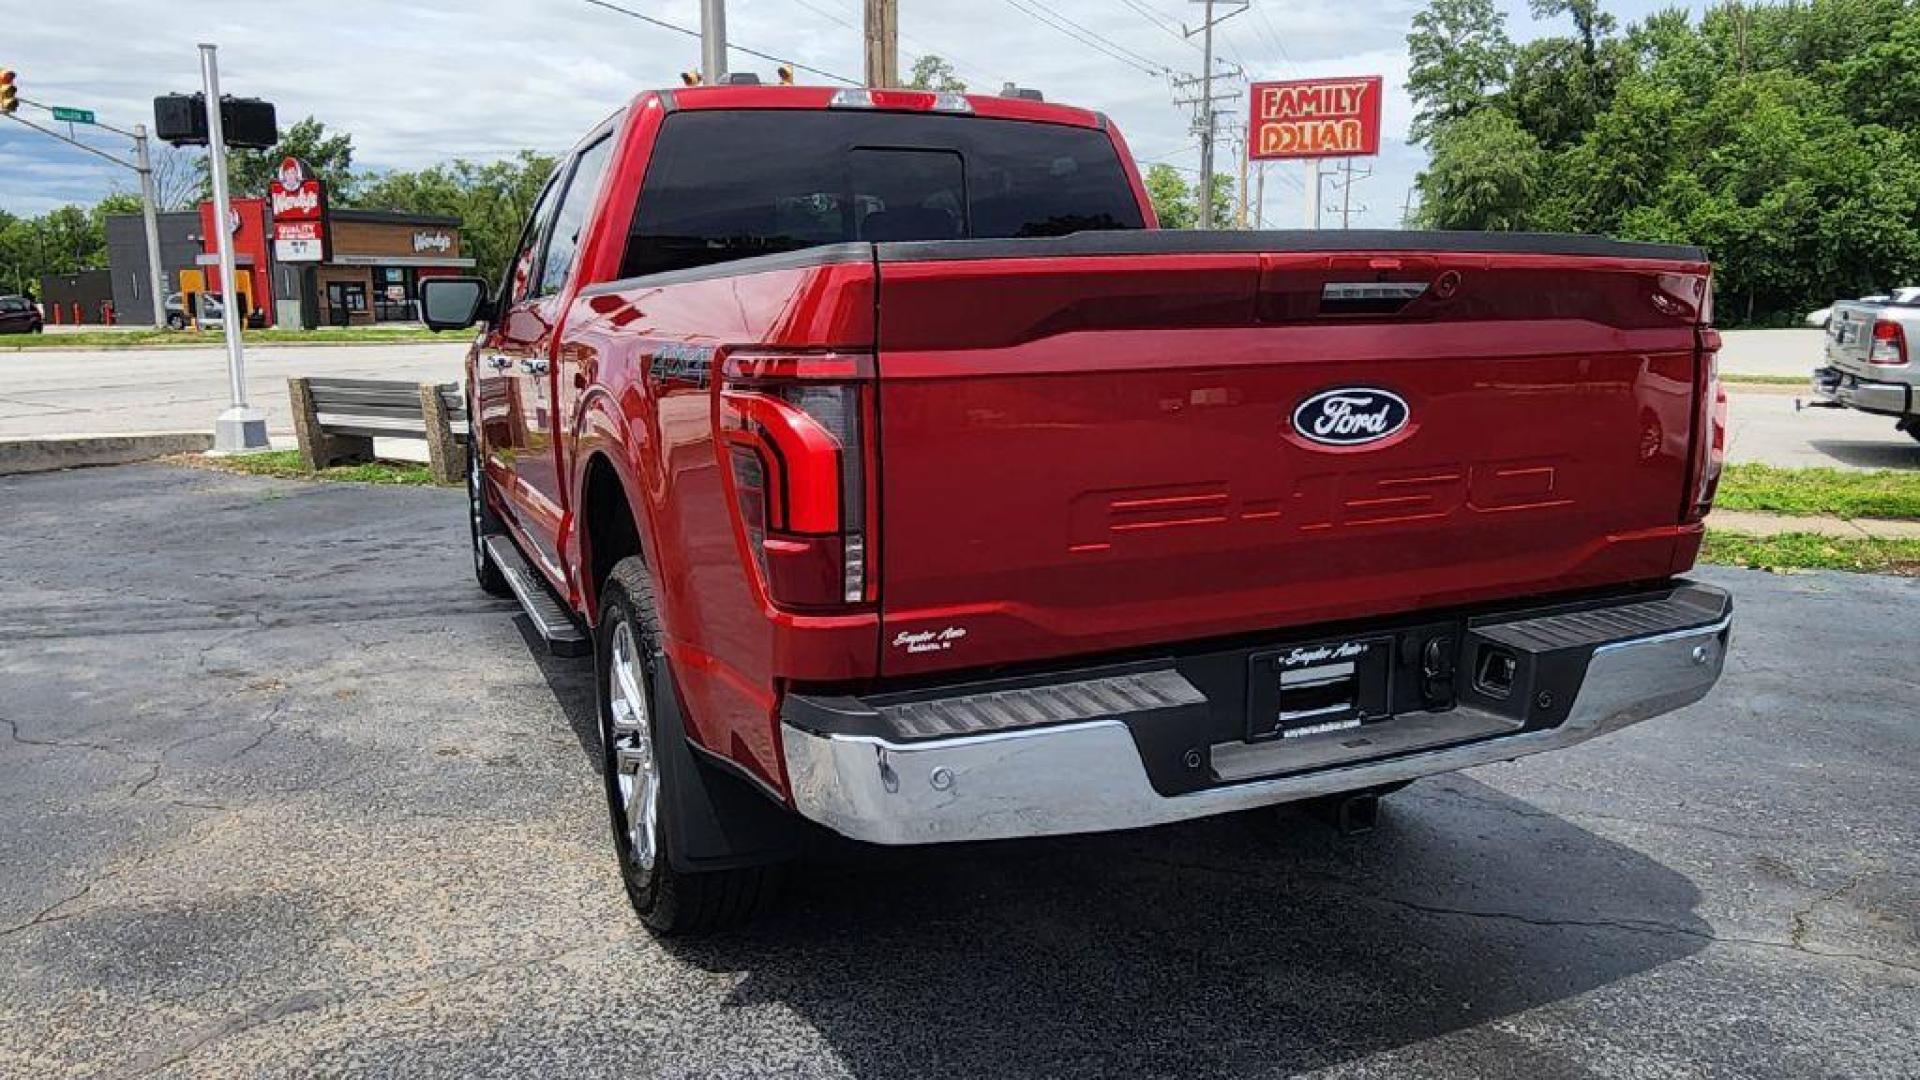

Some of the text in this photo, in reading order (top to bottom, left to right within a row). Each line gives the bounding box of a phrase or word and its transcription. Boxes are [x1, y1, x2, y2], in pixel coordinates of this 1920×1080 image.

[1261, 82, 1368, 119] FAMILY
[1261, 119, 1361, 154] DOLLAR
[1313, 397, 1391, 434] Ford
[1069, 455, 1578, 552] F-150
[1330, 642, 1362, 659] Auto
